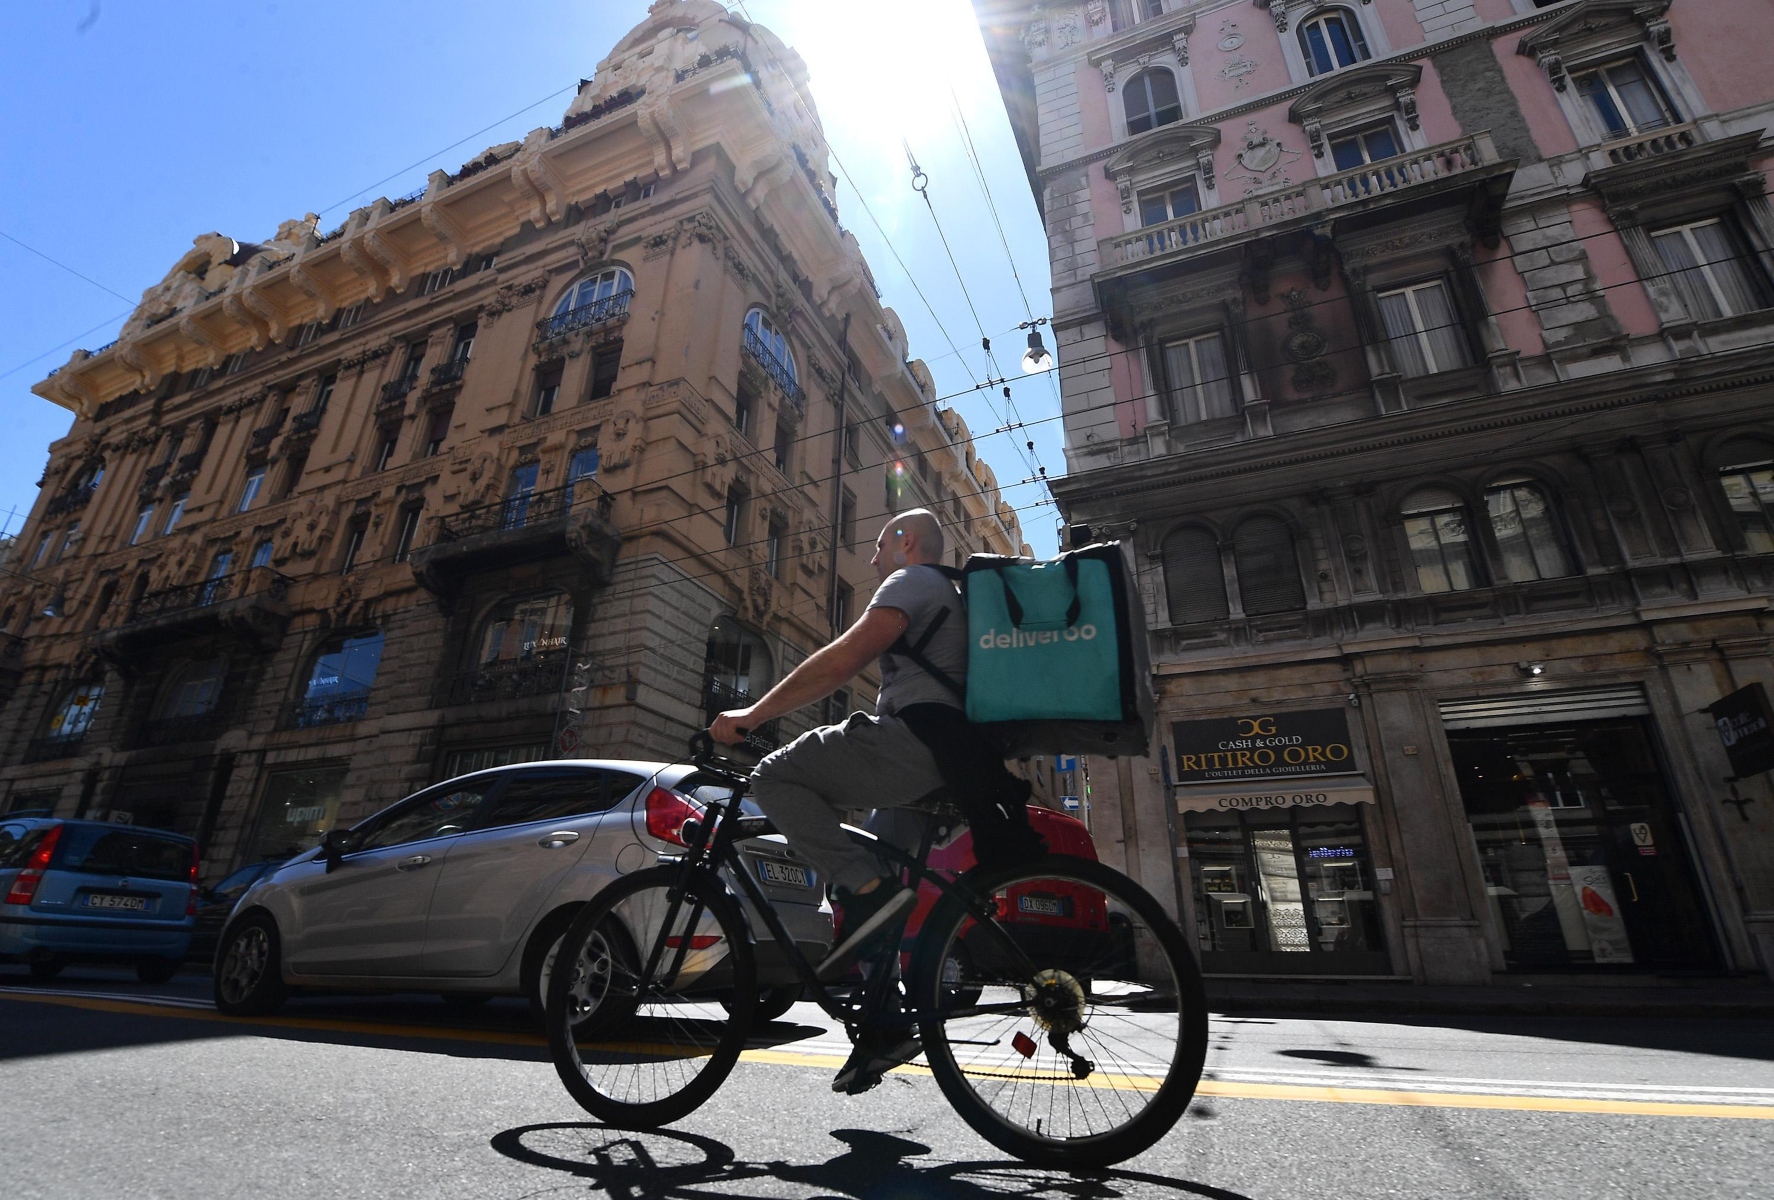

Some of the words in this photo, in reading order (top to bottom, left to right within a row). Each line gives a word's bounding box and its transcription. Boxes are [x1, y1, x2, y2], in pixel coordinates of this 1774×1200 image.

[980, 624, 1097, 649] deliveroo
[1218, 740, 1252, 751] CASH
[1255, 739, 1265, 748] &
[1266, 735, 1302, 747] GOLD
[1181, 749, 1276, 771] RITIRO
[1283, 743, 1349, 764] ORO
[1205, 769, 1243, 778] L'OUTLET
[1244, 767, 1271, 776] DELLA
[1273, 764, 1326, 774] GIOIELLERIA
[1218, 795, 1287, 808] COMPRO
[1292, 793, 1328, 805] ORO
[286, 806, 326, 827] upim
[765, 863, 779, 880] EL
[779, 866, 806, 884] 320CY
[91, 895, 105, 906] CY
[109, 896, 145, 909] 574DM
[1024, 898, 1034, 909] DX
